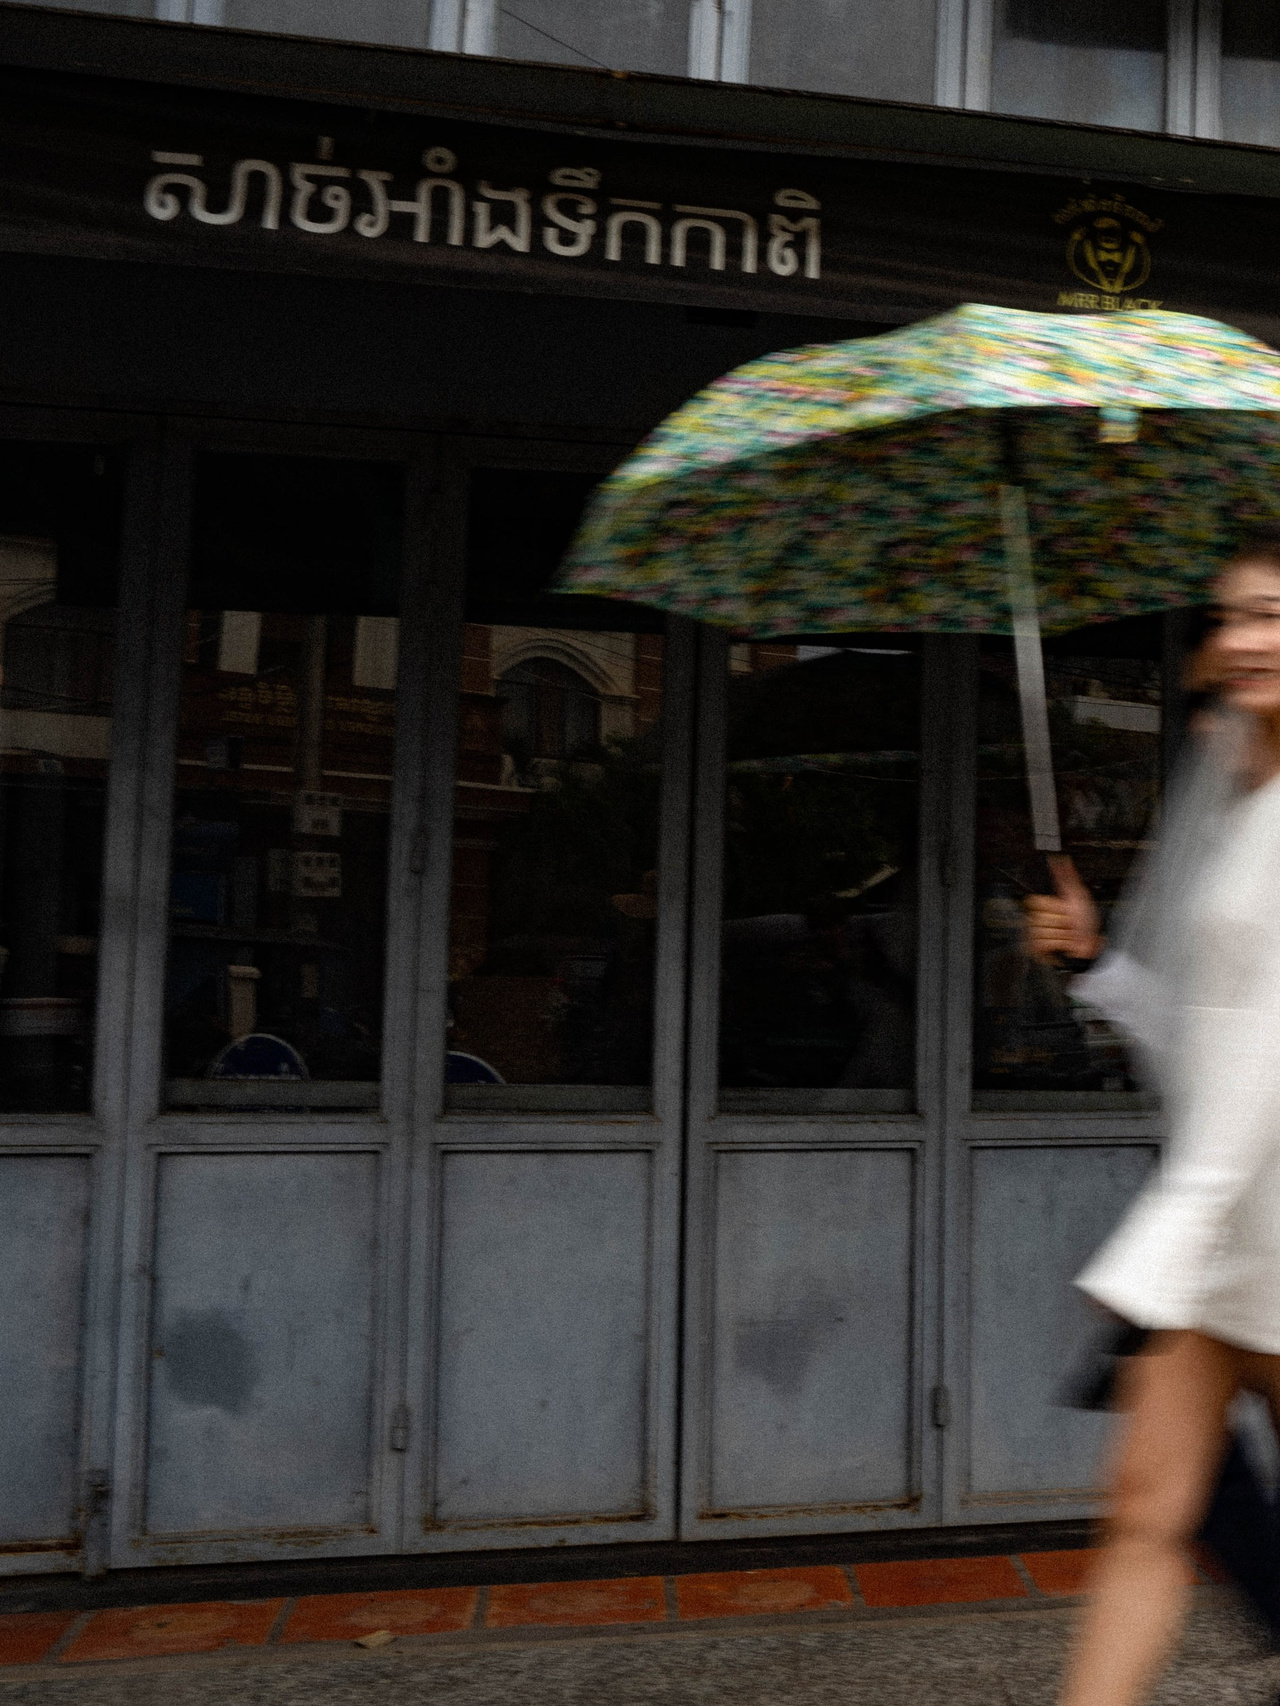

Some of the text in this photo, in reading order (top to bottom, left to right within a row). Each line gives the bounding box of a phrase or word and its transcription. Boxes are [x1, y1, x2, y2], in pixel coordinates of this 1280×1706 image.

[143, 136, 823, 281] សាច់អាំងទឹកកាពិ
